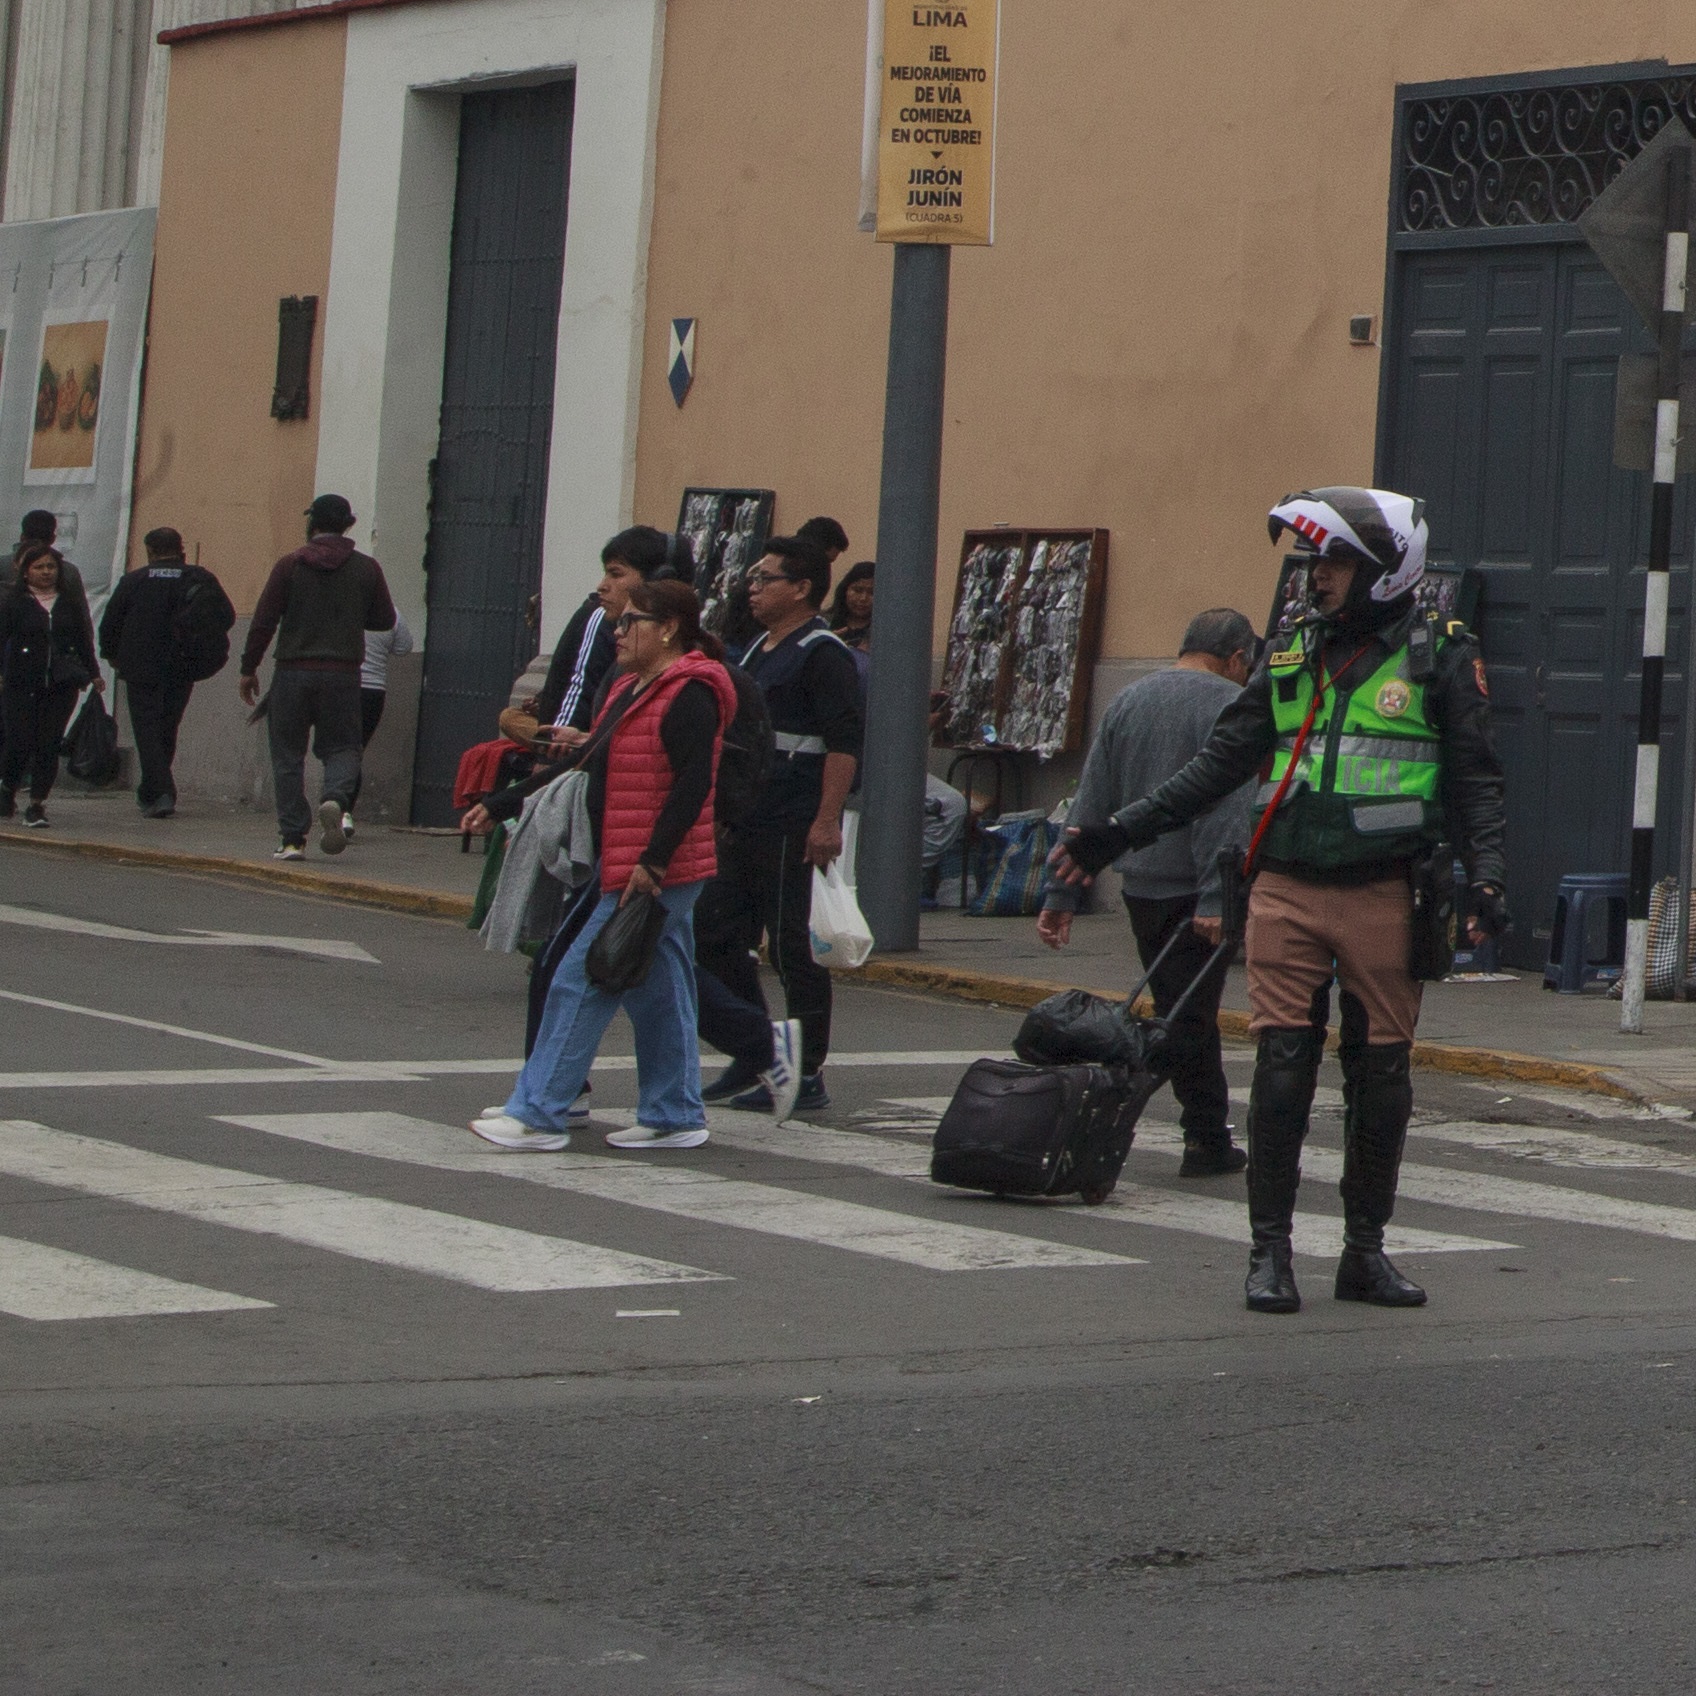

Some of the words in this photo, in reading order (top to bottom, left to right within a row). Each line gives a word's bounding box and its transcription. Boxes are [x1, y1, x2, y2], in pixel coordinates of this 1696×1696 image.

[913, 11, 967, 27] LIMA
[891, 66, 986, 82] MEJORAMIENTO
[915, 87, 934, 103] DE
[938, 83, 961, 103] VÍA
[900, 108, 971, 123] COMIENZA
[892, 128, 910, 143] EN
[914, 129, 981, 144] OCTUBRE!
[907, 165, 962, 185] JIRÓN
[906, 187, 962, 207] JUNÍN
[905, 212, 949, 223] (CUADRA
